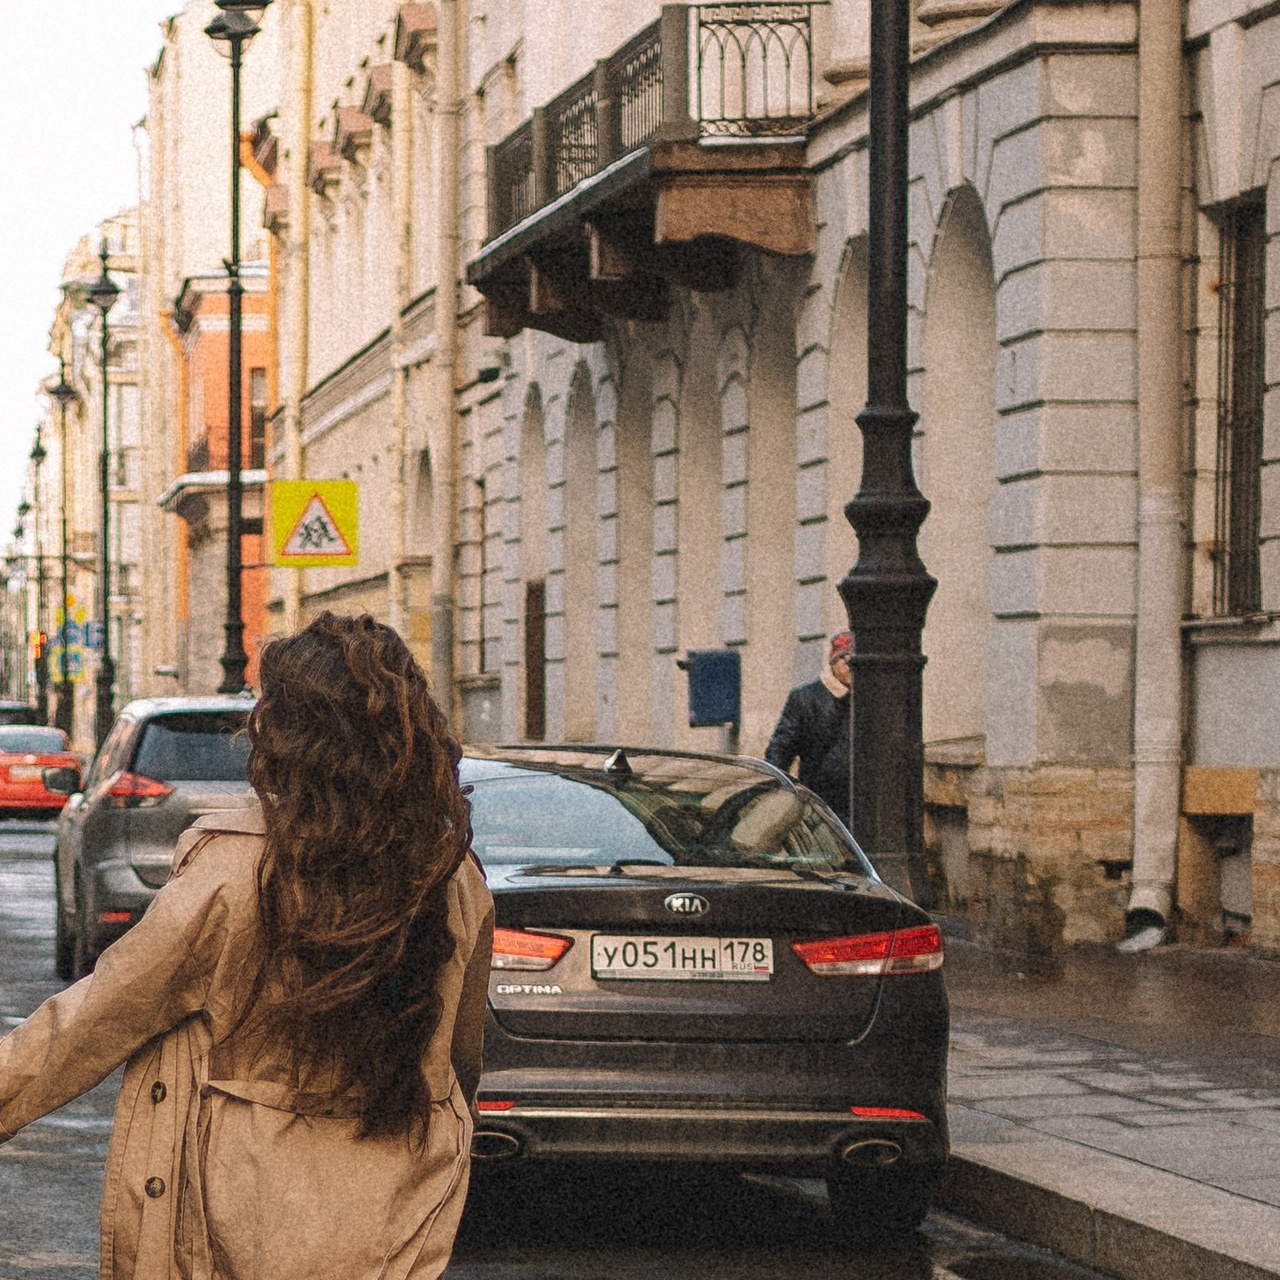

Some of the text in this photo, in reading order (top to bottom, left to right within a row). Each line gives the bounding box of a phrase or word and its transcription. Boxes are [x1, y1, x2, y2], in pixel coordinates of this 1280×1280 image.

[670, 897, 703, 913] KIA
[723, 941, 766, 962] 178
[732, 962, 753, 971] RUS
[496, 984, 563, 995] OPTIMA
